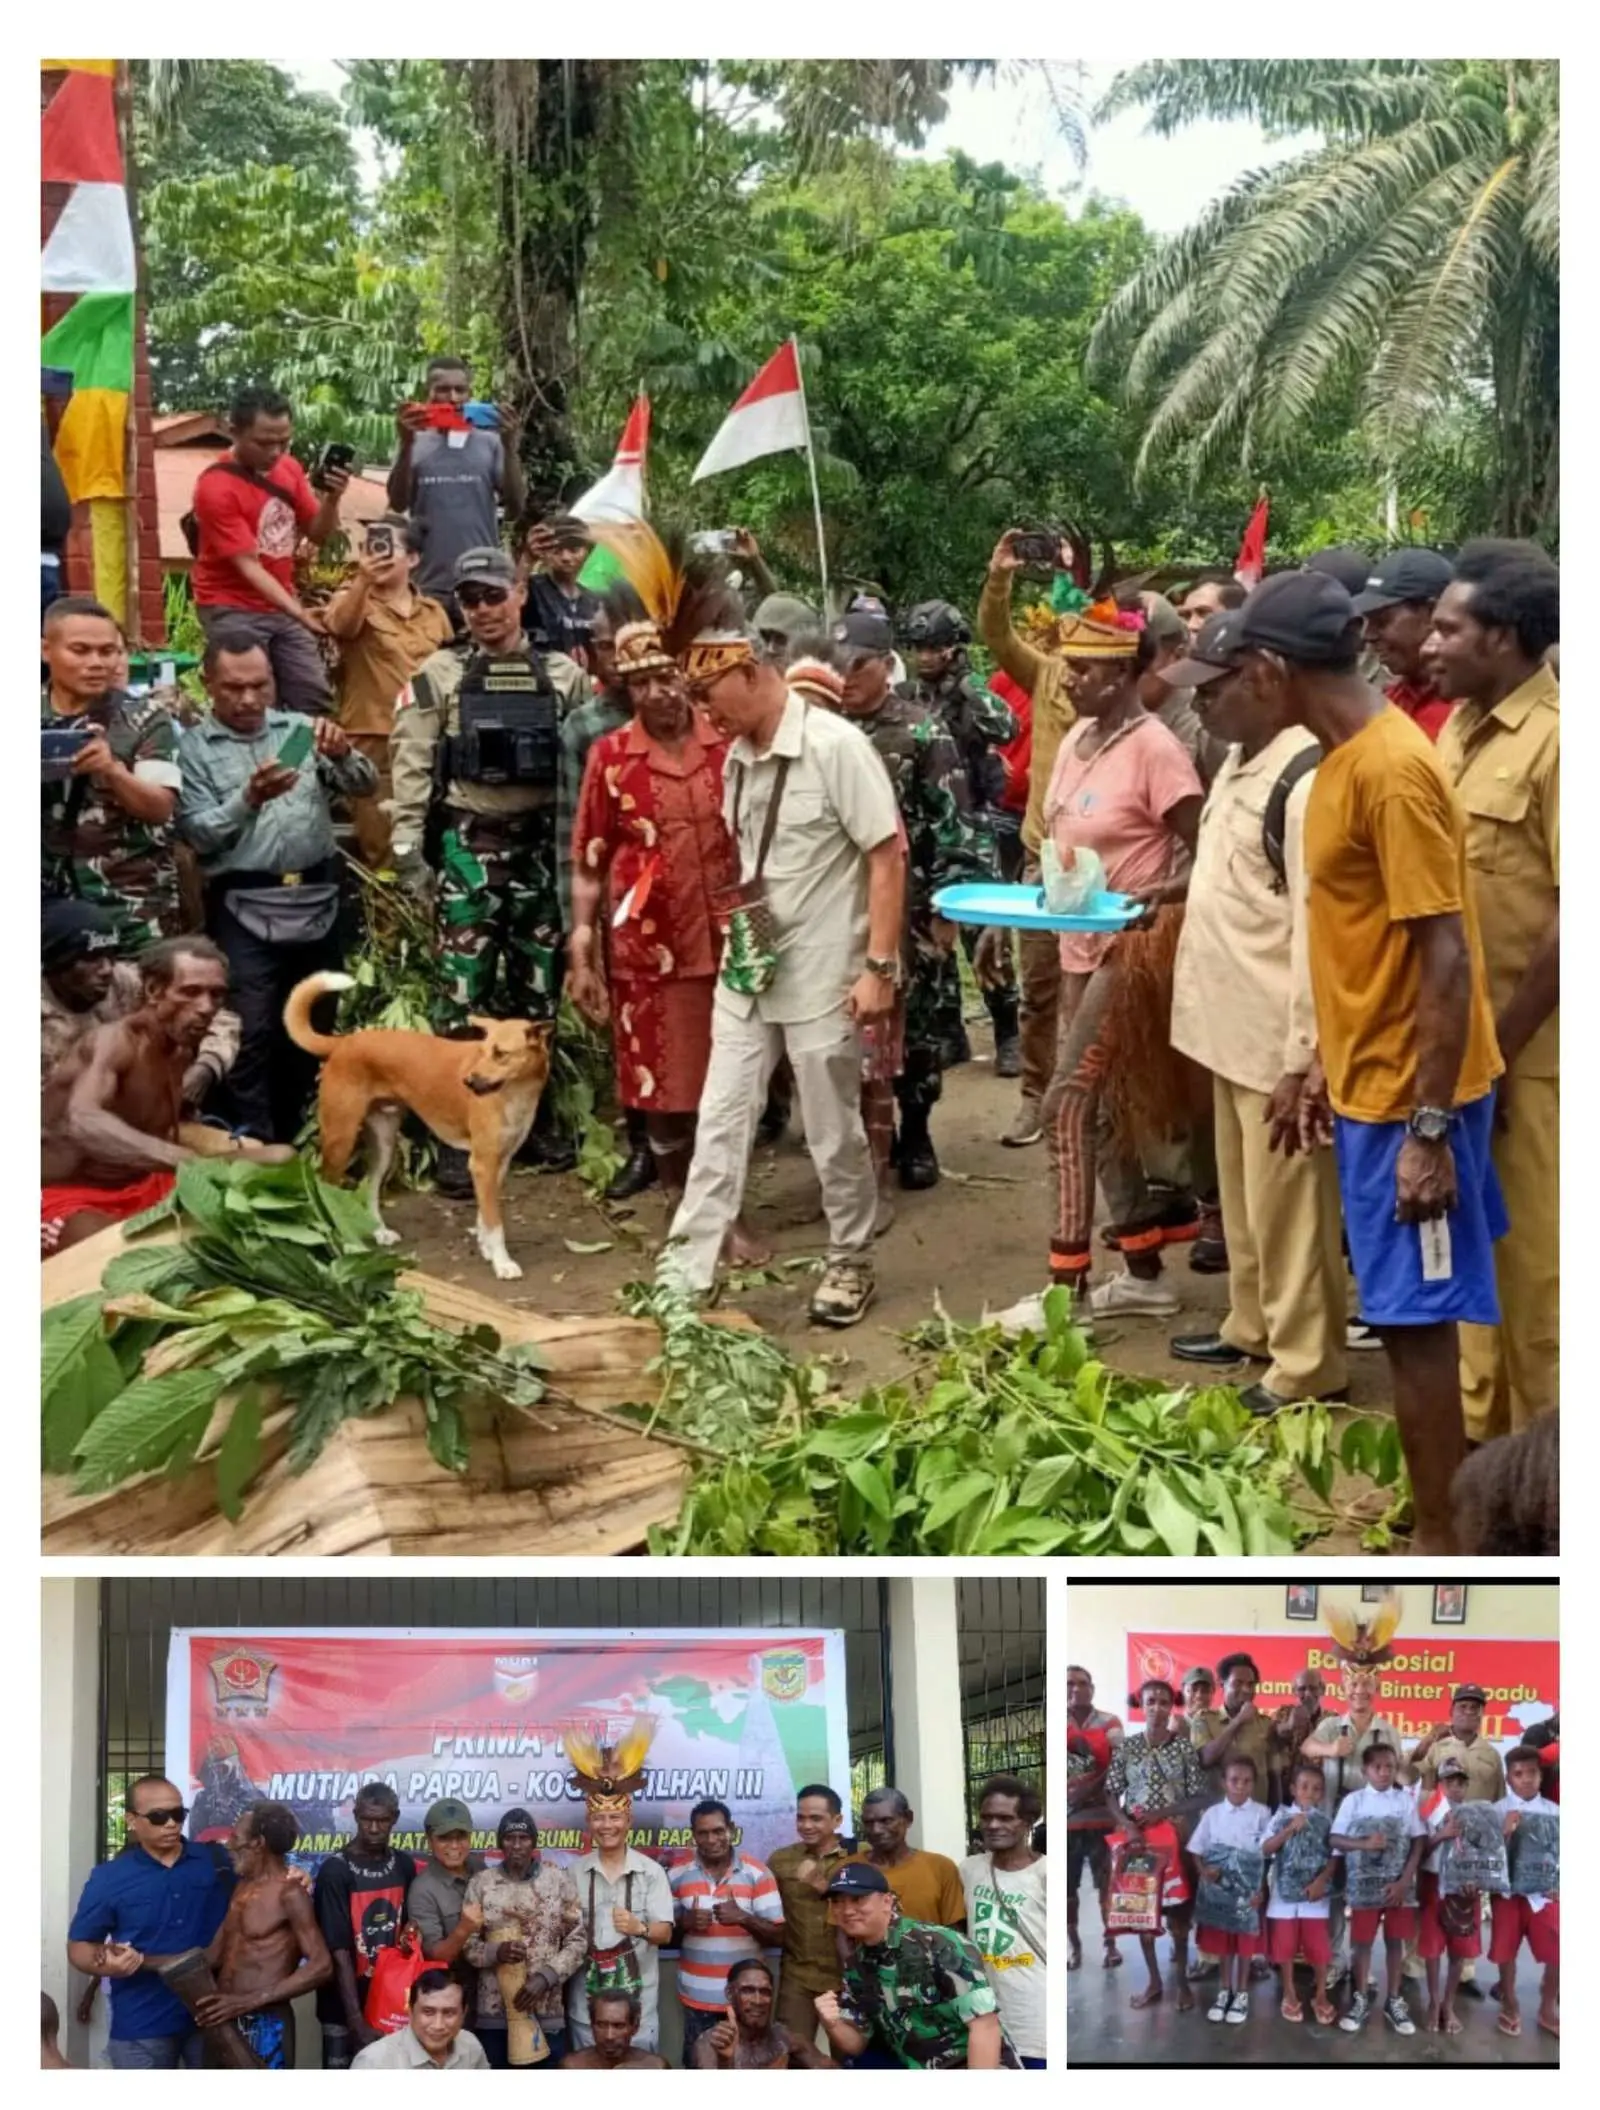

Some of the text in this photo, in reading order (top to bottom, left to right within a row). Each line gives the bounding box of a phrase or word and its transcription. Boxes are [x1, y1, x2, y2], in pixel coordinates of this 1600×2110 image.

[1380, 1680, 1443, 1700] Binter
[1447, 1682, 1538, 1702] Tpadu
[407, 1772, 501, 1802] PAPUA
[526, 1770, 730, 1802] KOILHAN
